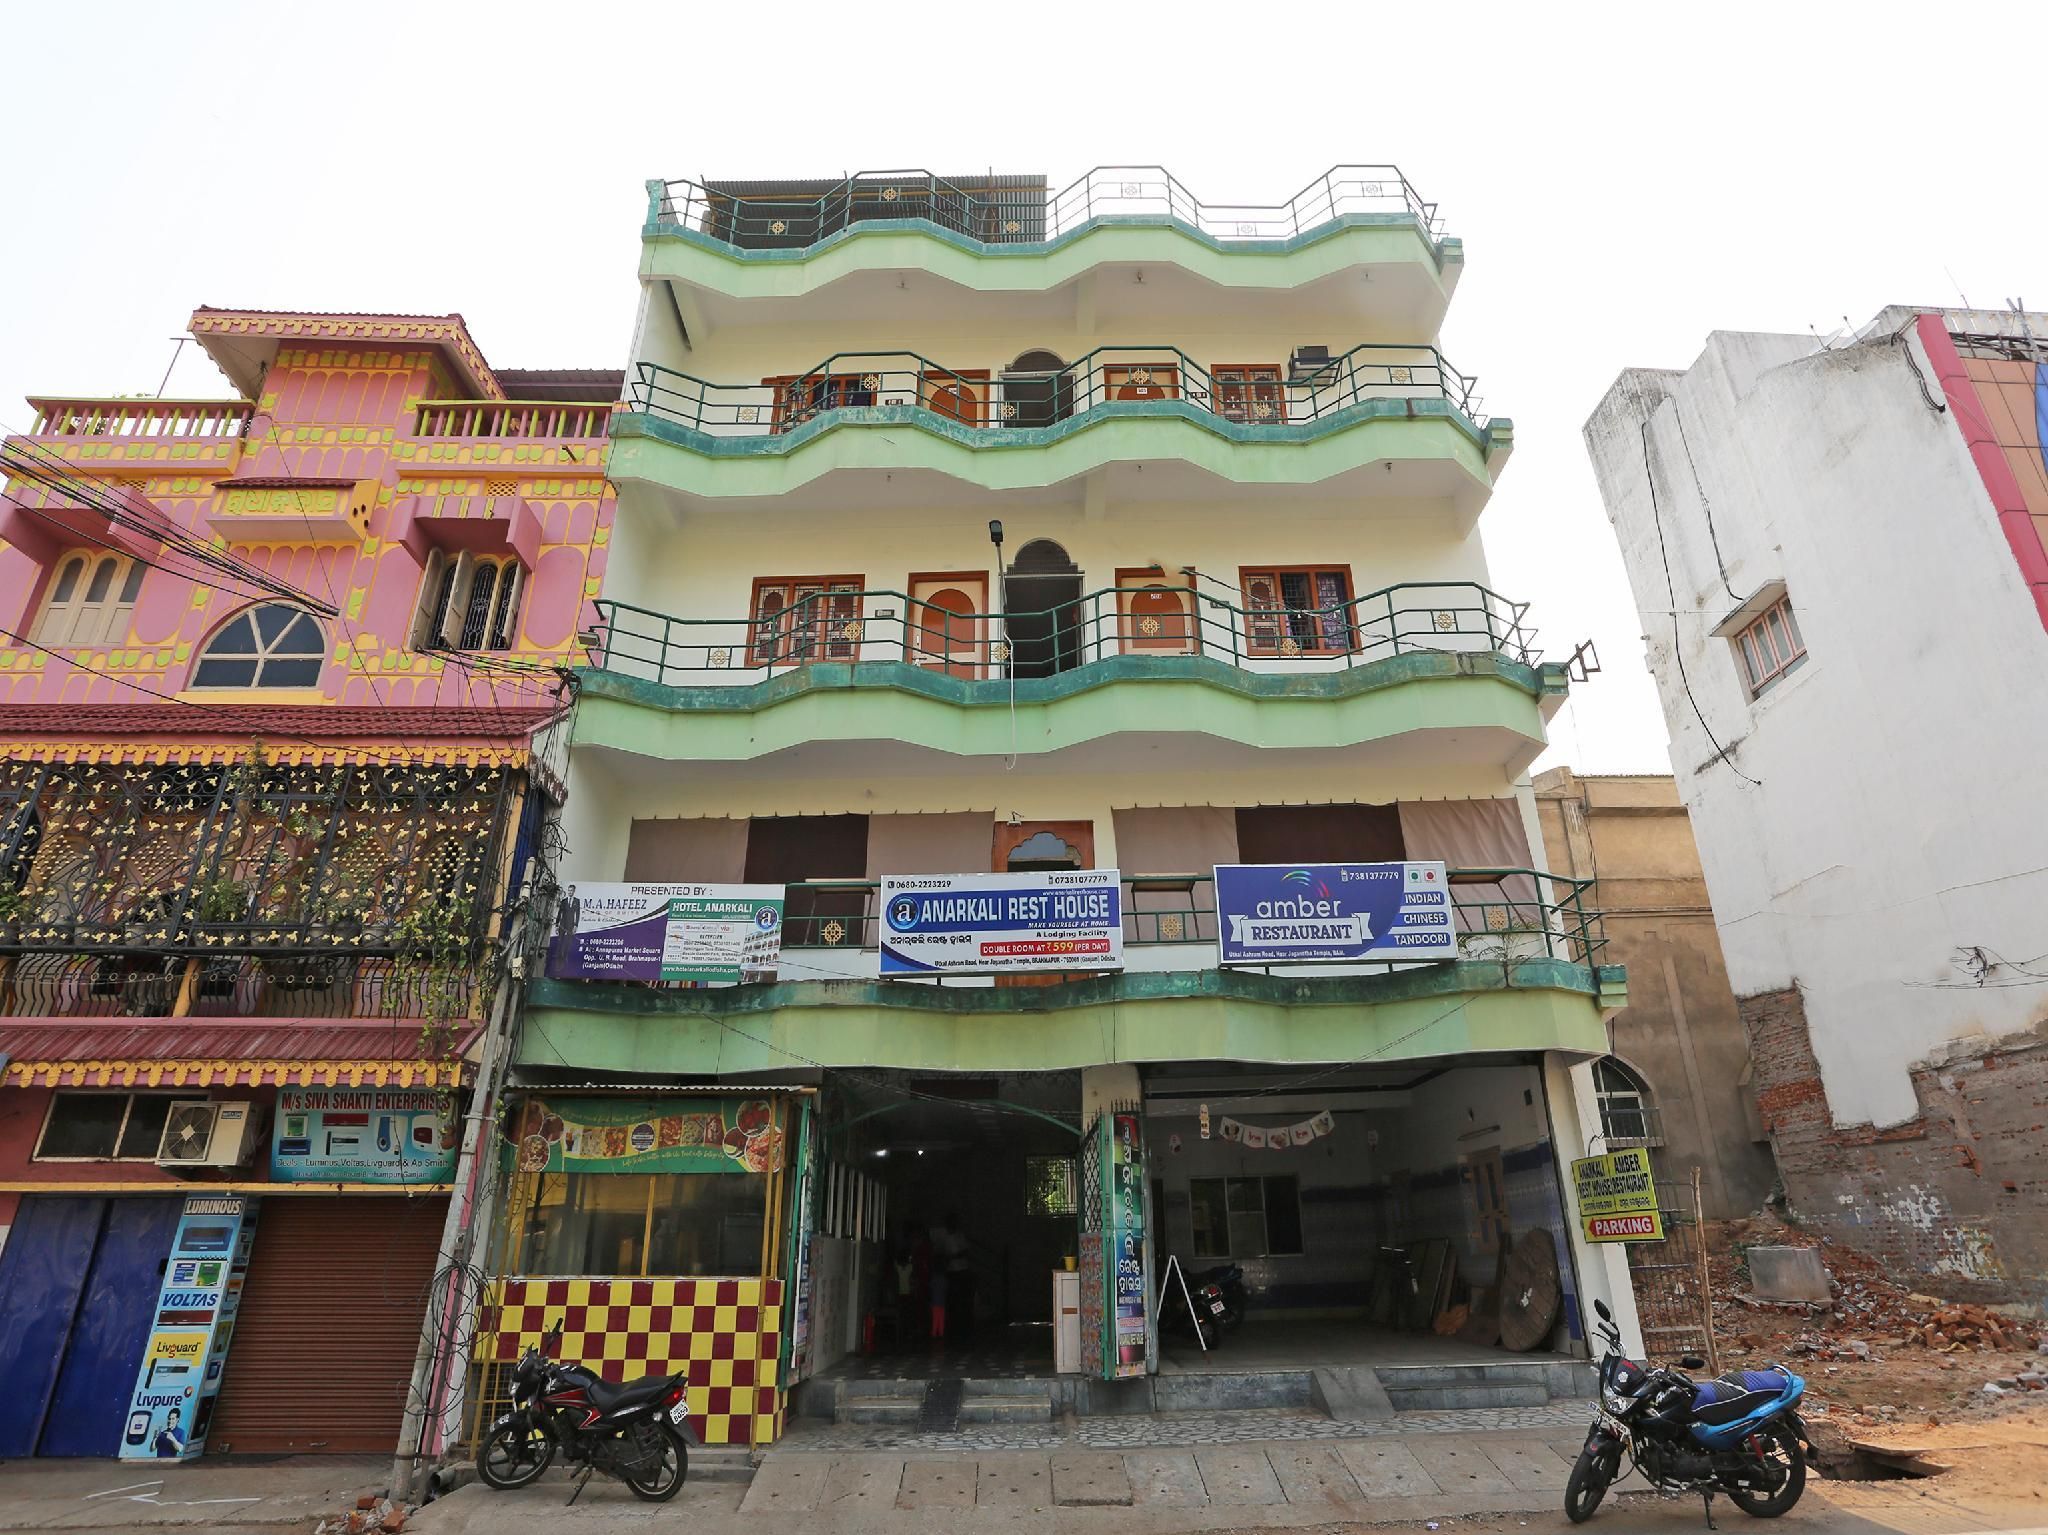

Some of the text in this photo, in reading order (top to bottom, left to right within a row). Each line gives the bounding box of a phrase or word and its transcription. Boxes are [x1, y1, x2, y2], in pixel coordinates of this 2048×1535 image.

[1055, 876, 1108, 885] 07381077779
[1349, 871, 1400, 880] 7381377779
[896, 880, 952, 889] 0680-2223229
[631, 887, 691, 897] PRESENTED
[693, 887, 707, 896] BY
[584, 898, 648, 910] M.A.HAFEEZ
[1405, 893, 1441, 904] INDIAN
[672, 903, 753, 914] HOTEL ANARKALI
[921, 894, 1110, 923] ANARKALI REST HOUSE
[1256, 894, 1342, 918] amber
[1403, 913, 1445, 924] CHINESE
[1028, 921, 1046, 929] MAKE
[1044, 931, 1076, 940] Lodging
[1078, 929, 1108, 938] Facility
[1251, 924, 1353, 941] RESTAURANT
[1394, 934, 1448, 945] TANDOORI
[983, 945, 1011, 955] DOUBLE
[1013, 943, 1035, 953] ROOM
[1037, 943, 1046, 952] AT
[282, 1091, 450, 1110] M/s SIVA SHAKTI ENTERPRISS
[402, 1158, 409, 1168] &
[424, 1158, 449, 1168] Smith
[1614, 1153, 1642, 1174] AMBER
[1612, 1172, 1650, 1195] RESTAURANT
[185, 1199, 242, 1215] LUMINOUS
[1595, 1217, 1653, 1236] PARKING
[161, 1292, 219, 1307] VOLTAS
[156, 1341, 201, 1358] Livguard
[136, 1392, 183, 1409] Livpure
